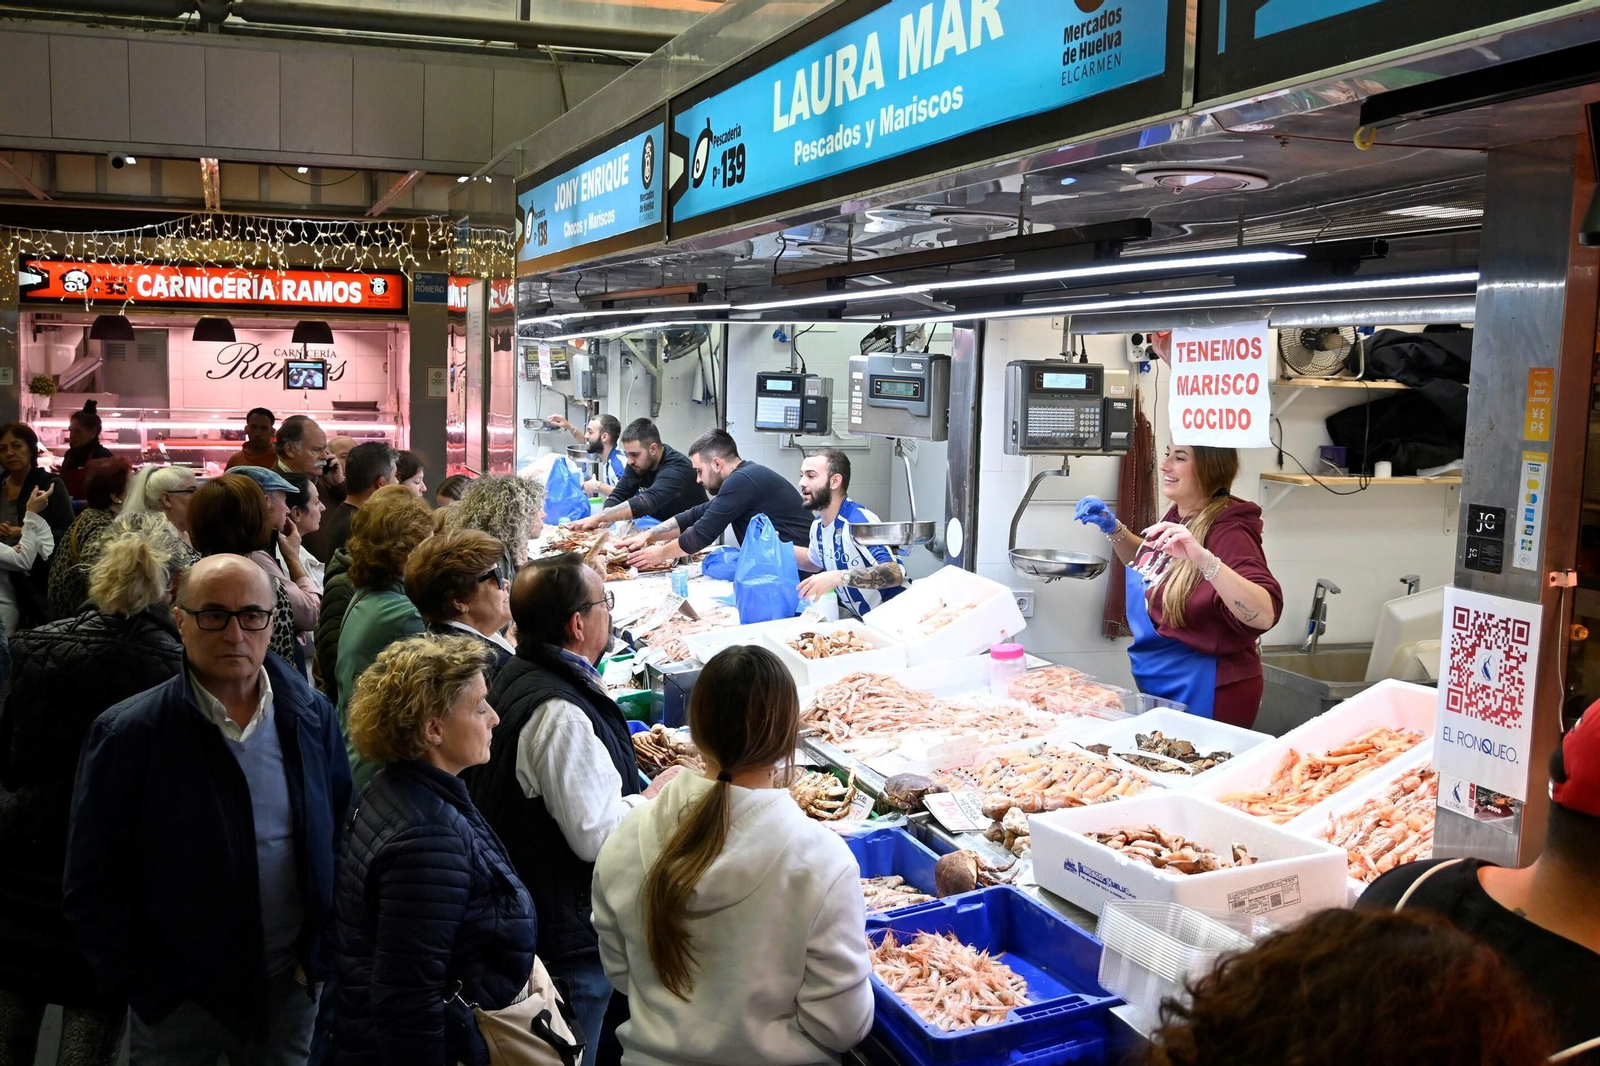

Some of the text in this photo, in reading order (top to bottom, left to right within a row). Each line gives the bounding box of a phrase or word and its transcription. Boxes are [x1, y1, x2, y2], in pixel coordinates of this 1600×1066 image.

[1063, 7, 1122, 45] Mercados
[1062, 30, 1122, 66] de Huelva
[773, 0, 1004, 132] LAURA MAR
[713, 123, 741, 148] Pescadería
[794, 85, 963, 166] Pescados y Mariscos
[555, 152, 630, 212] JONY ENRIQUE
[564, 220, 583, 238] Chocos
[588, 209, 615, 230] Mariscos
[137, 273, 362, 304] CARNICERÍA RAMOS
[415, 285, 445, 294] ROMERO
[274, 348, 337, 359] CARNCERÍA
[1176, 336, 1262, 363] TENEMOS
[1177, 373, 1260, 396] MARISCO
[1182, 408, 1251, 430] COCIDO
[1443, 726, 1454, 743] EL
